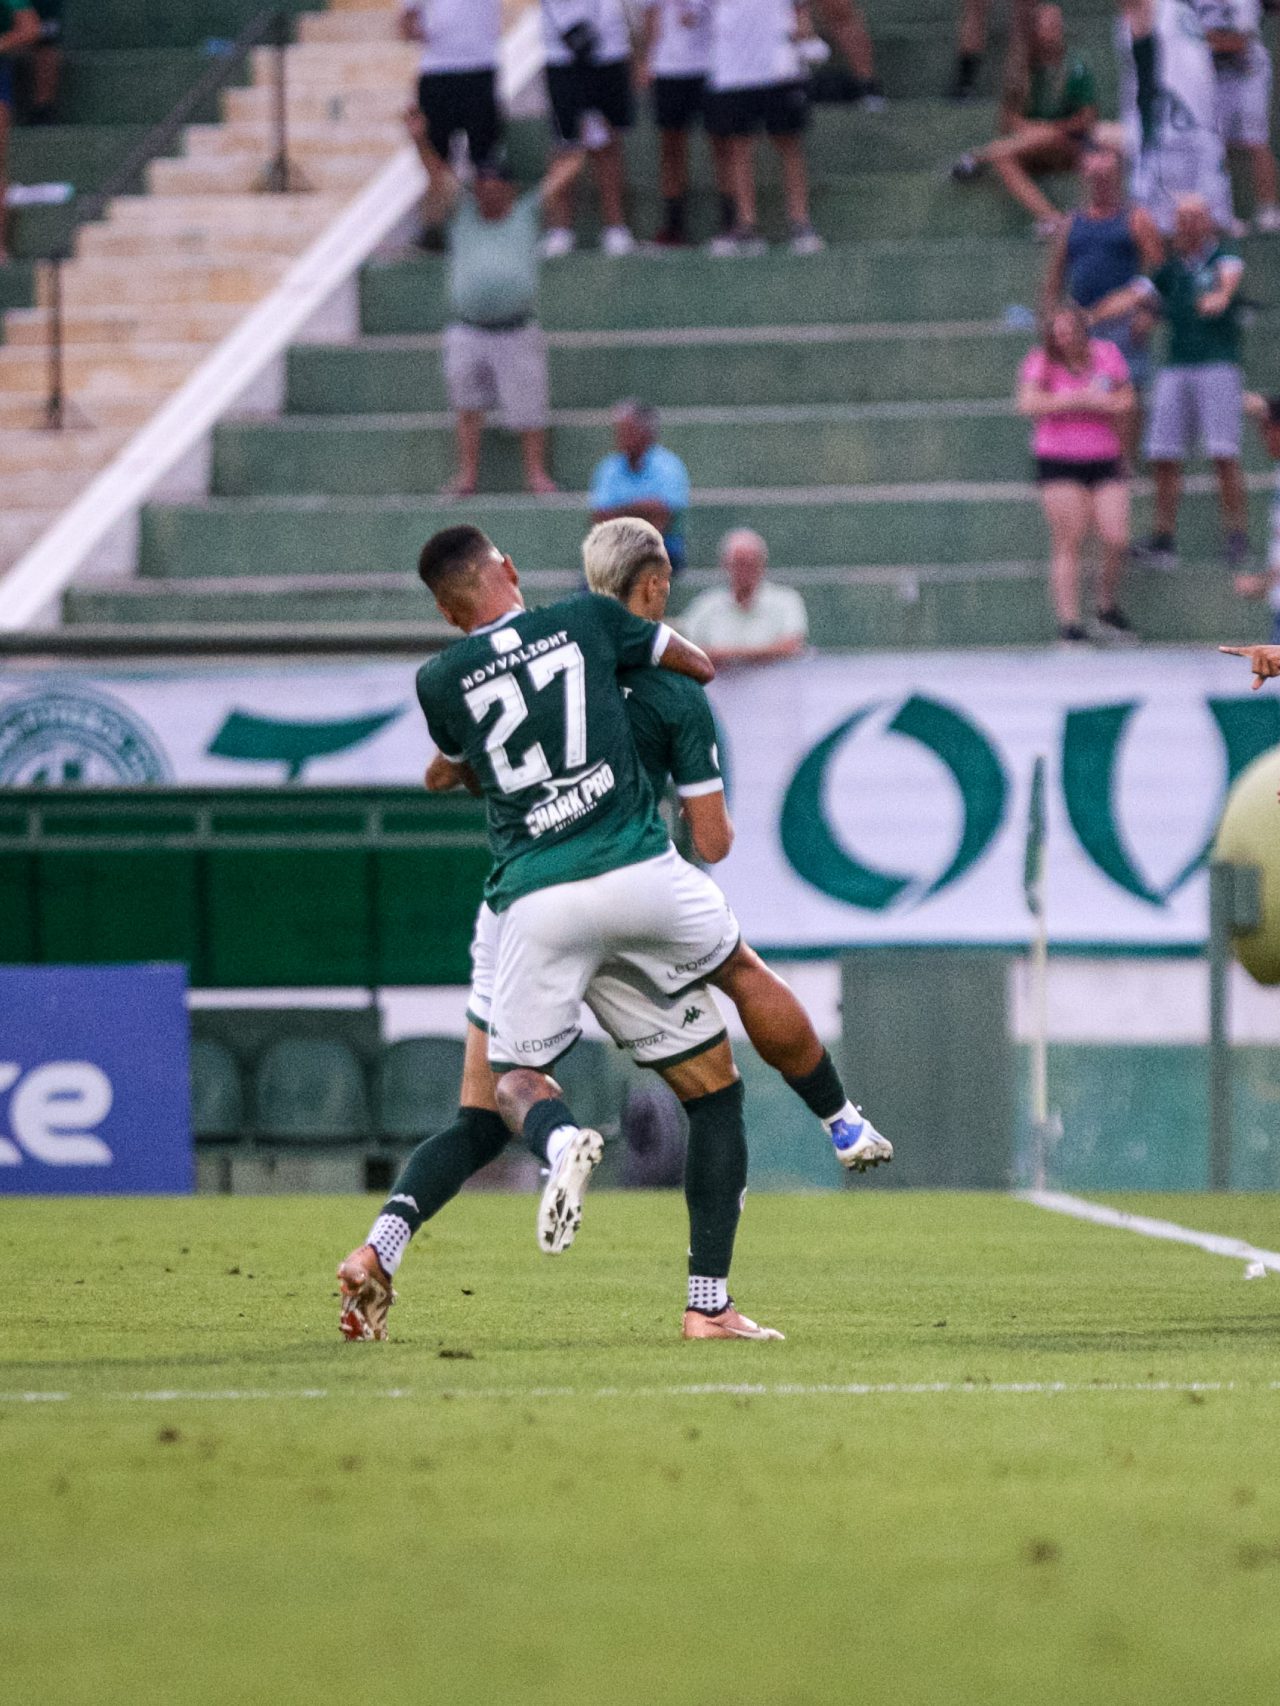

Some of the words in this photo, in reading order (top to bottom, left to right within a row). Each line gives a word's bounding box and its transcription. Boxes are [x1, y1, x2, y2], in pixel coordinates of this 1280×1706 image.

[464, 642, 587, 794] 27
[525, 786, 585, 837] SHARK
[580, 763, 615, 805] PRO
